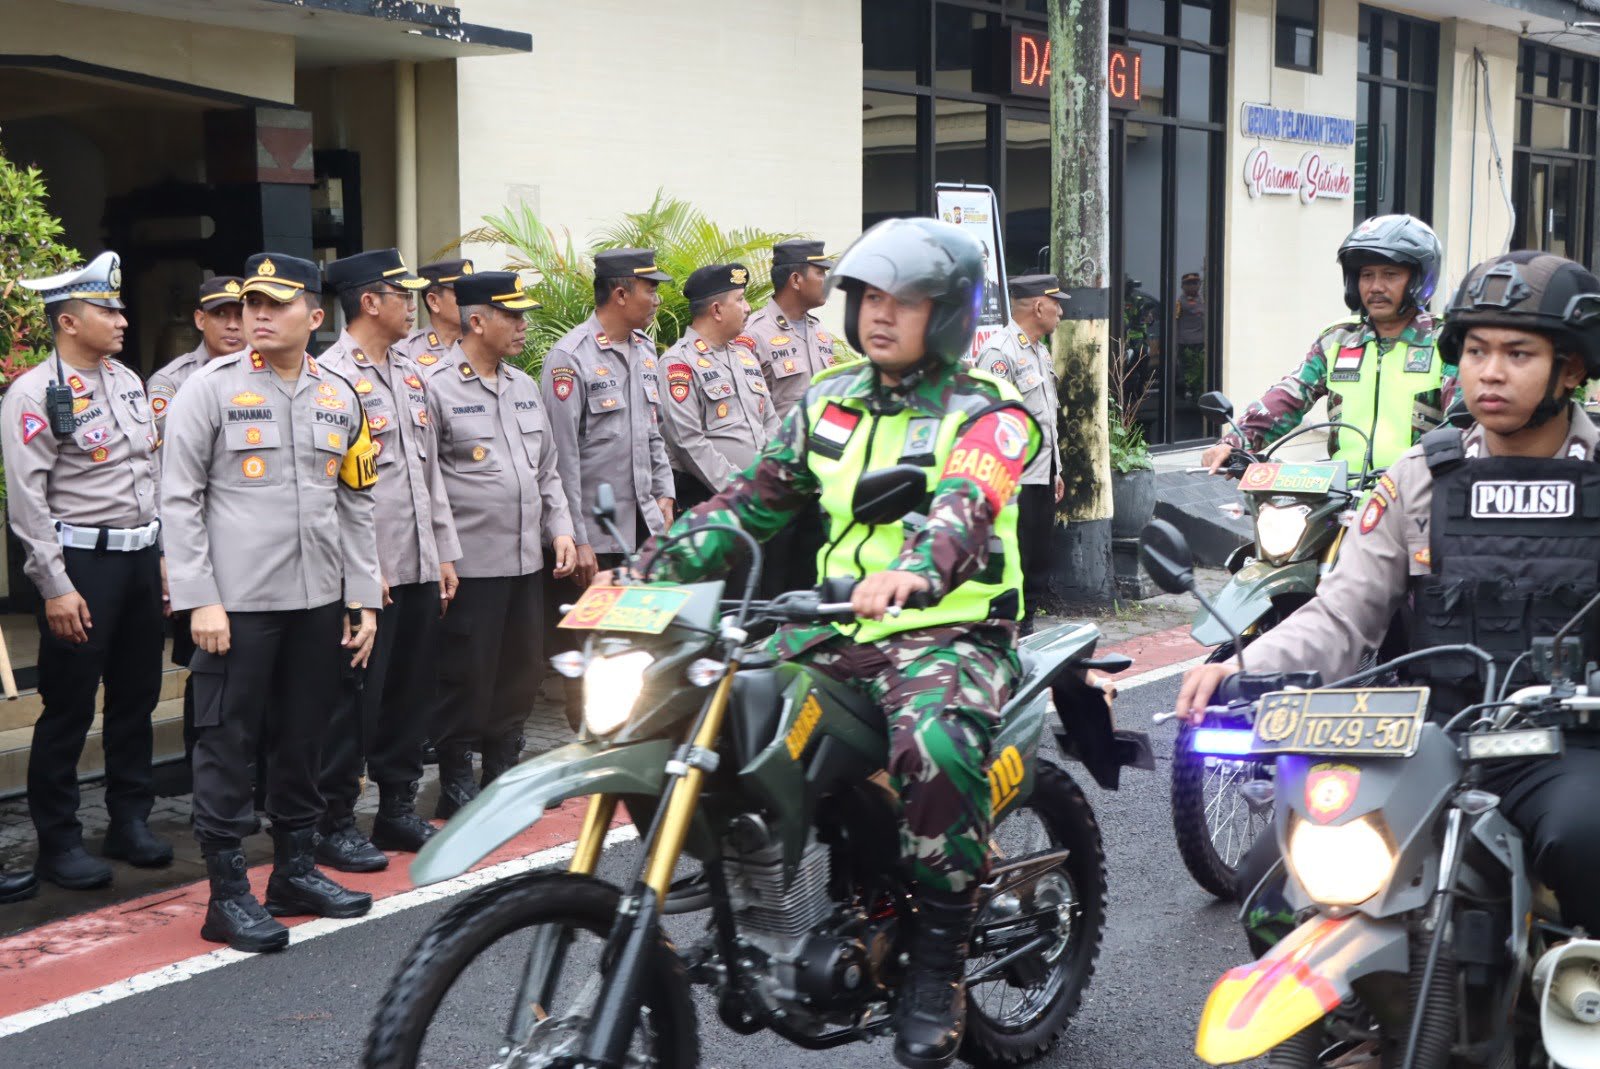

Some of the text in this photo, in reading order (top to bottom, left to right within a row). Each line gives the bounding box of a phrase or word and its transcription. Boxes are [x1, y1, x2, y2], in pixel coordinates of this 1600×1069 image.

[1247, 105, 1355, 145] GEDUNG PELAYANAN TERPADU
[1252, 150, 1299, 193] Parama
[771, 347, 798, 360] DWI P
[228, 409, 273, 422] MUHAMMAD
[514, 401, 538, 411] POLRI
[316, 411, 349, 427] POLRI
[1478, 485, 1568, 514] POLISI
[1352, 692, 1371, 713] X
[1304, 716, 1410, 748] 1049-50
